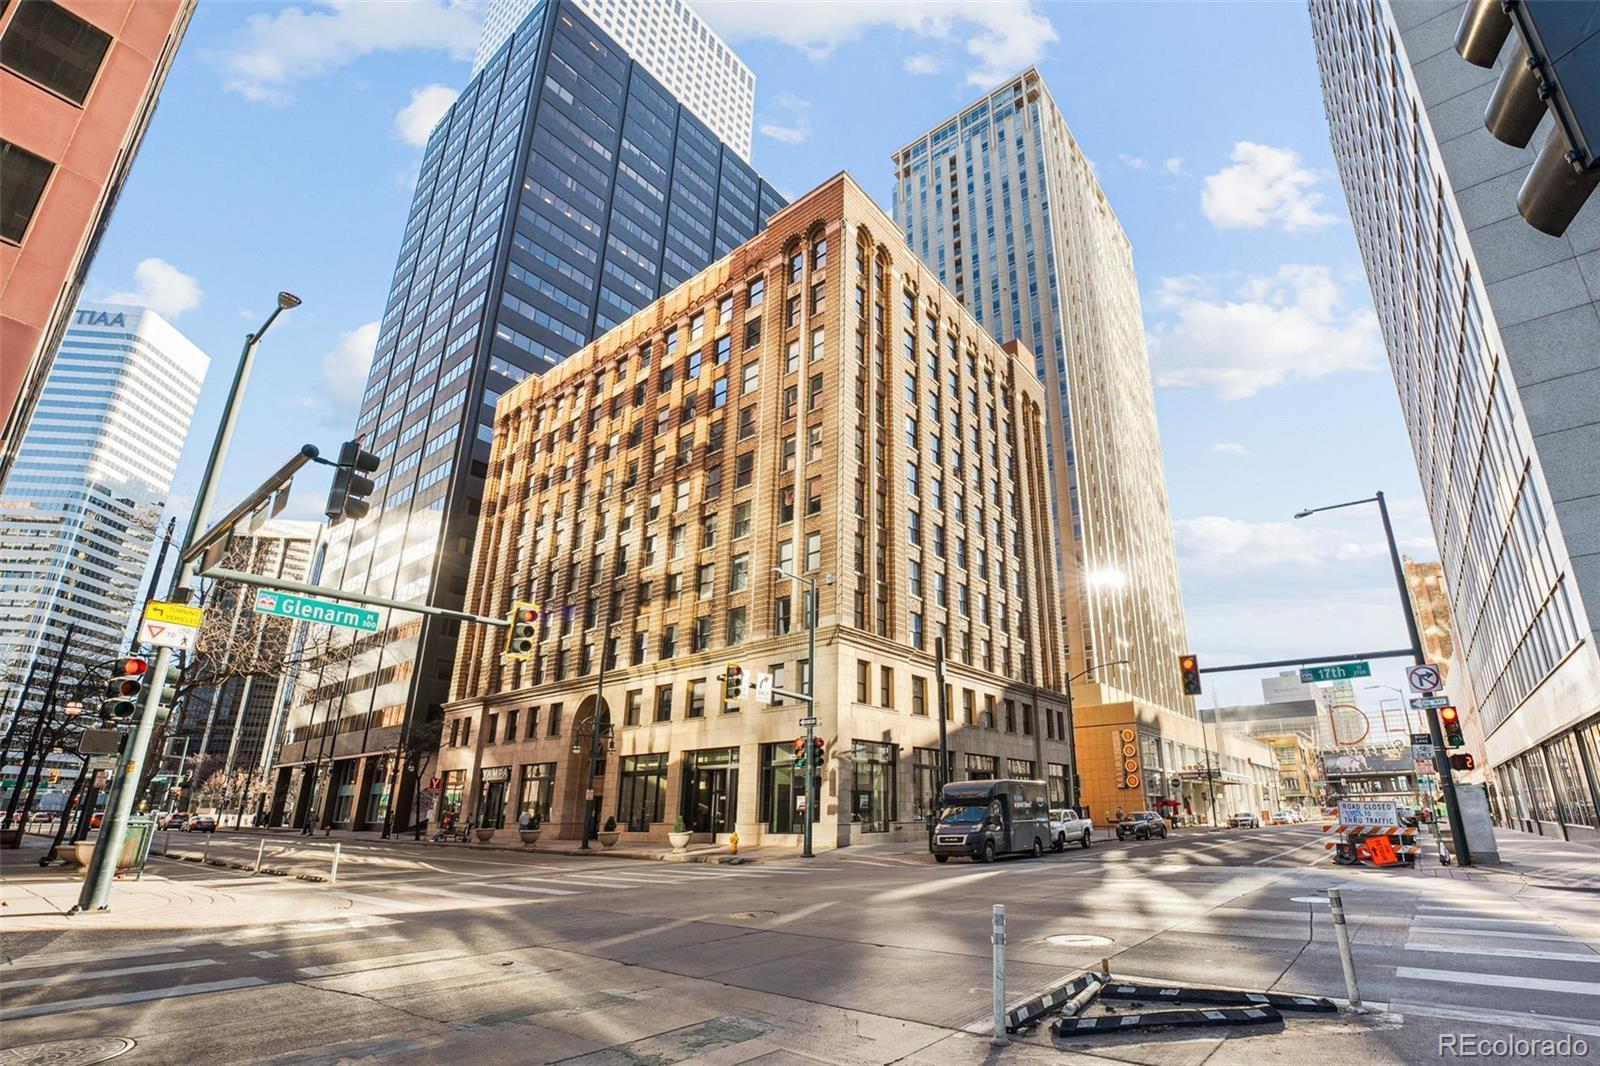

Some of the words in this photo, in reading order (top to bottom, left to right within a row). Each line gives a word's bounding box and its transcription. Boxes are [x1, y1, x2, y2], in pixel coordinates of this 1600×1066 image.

[75, 310, 125, 327] TIAA
[282, 599, 359, 626] Glenarm
[1318, 667, 1346, 679] 17th
